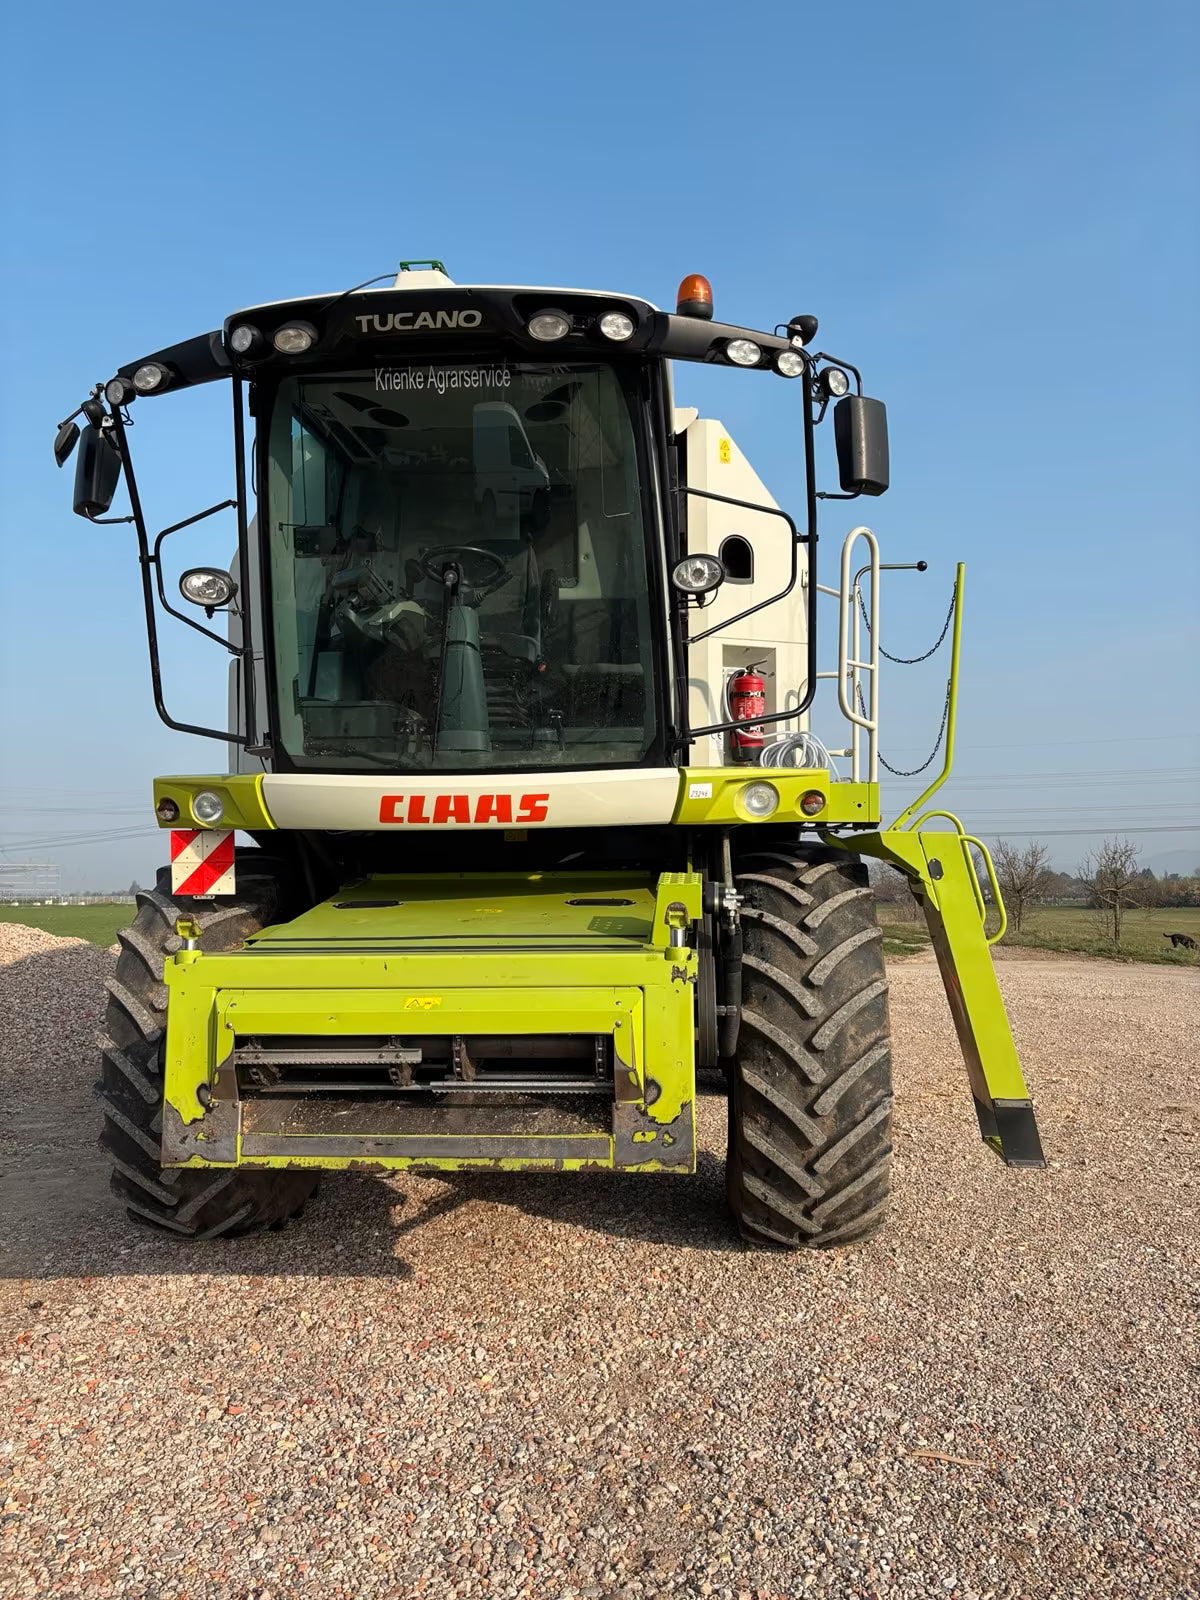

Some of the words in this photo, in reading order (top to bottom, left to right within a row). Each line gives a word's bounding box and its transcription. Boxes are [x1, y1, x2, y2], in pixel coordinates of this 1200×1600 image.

[355, 310, 482, 333] TUCANO
[375, 366, 424, 391] Krienke
[427, 364, 511, 395] Agrarservice
[379, 793, 550, 824] CLAAS
